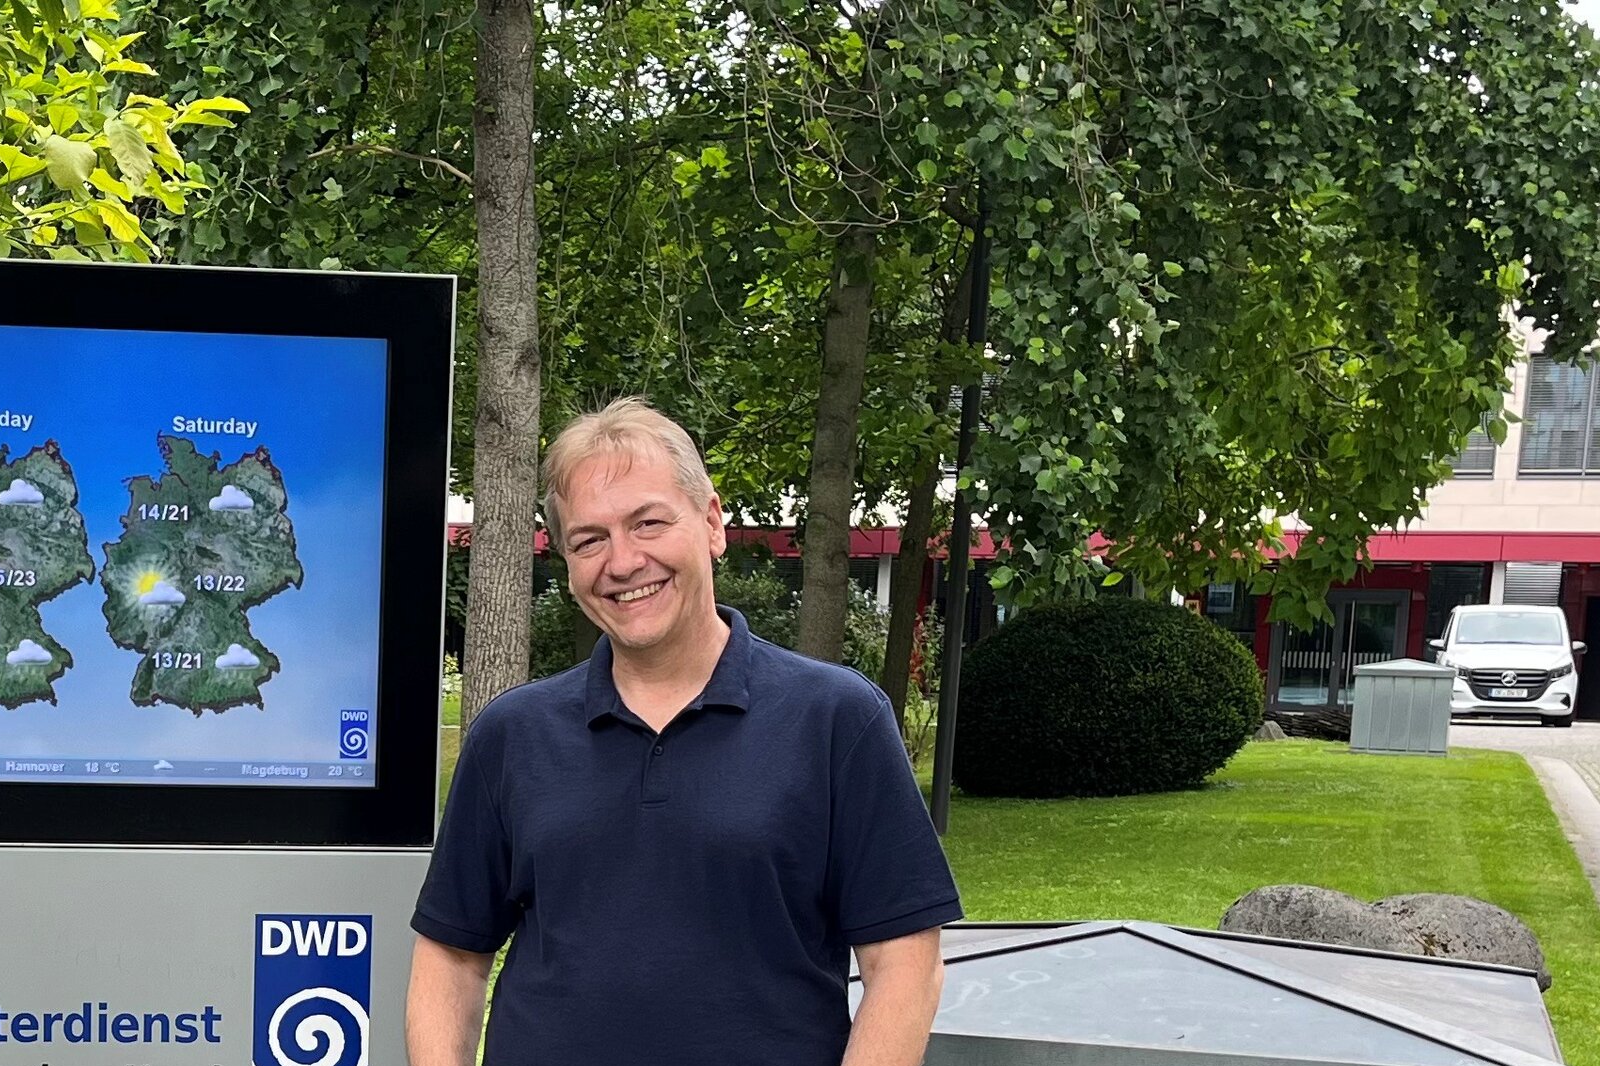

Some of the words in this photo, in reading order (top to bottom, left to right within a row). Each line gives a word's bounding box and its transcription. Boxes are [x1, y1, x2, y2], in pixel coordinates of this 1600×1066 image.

[173, 416, 257, 437] Saturday
[138, 504, 189, 521] 14/21
[194, 574, 245, 592] 13/22
[152, 652, 202, 669] 13/21
[341, 711, 368, 722] DWD
[6, 760, 65, 773] Hannover
[105, 762, 121, 773] °C
[241, 764, 309, 778] Magdeburg
[261, 920, 367, 956] DWD
